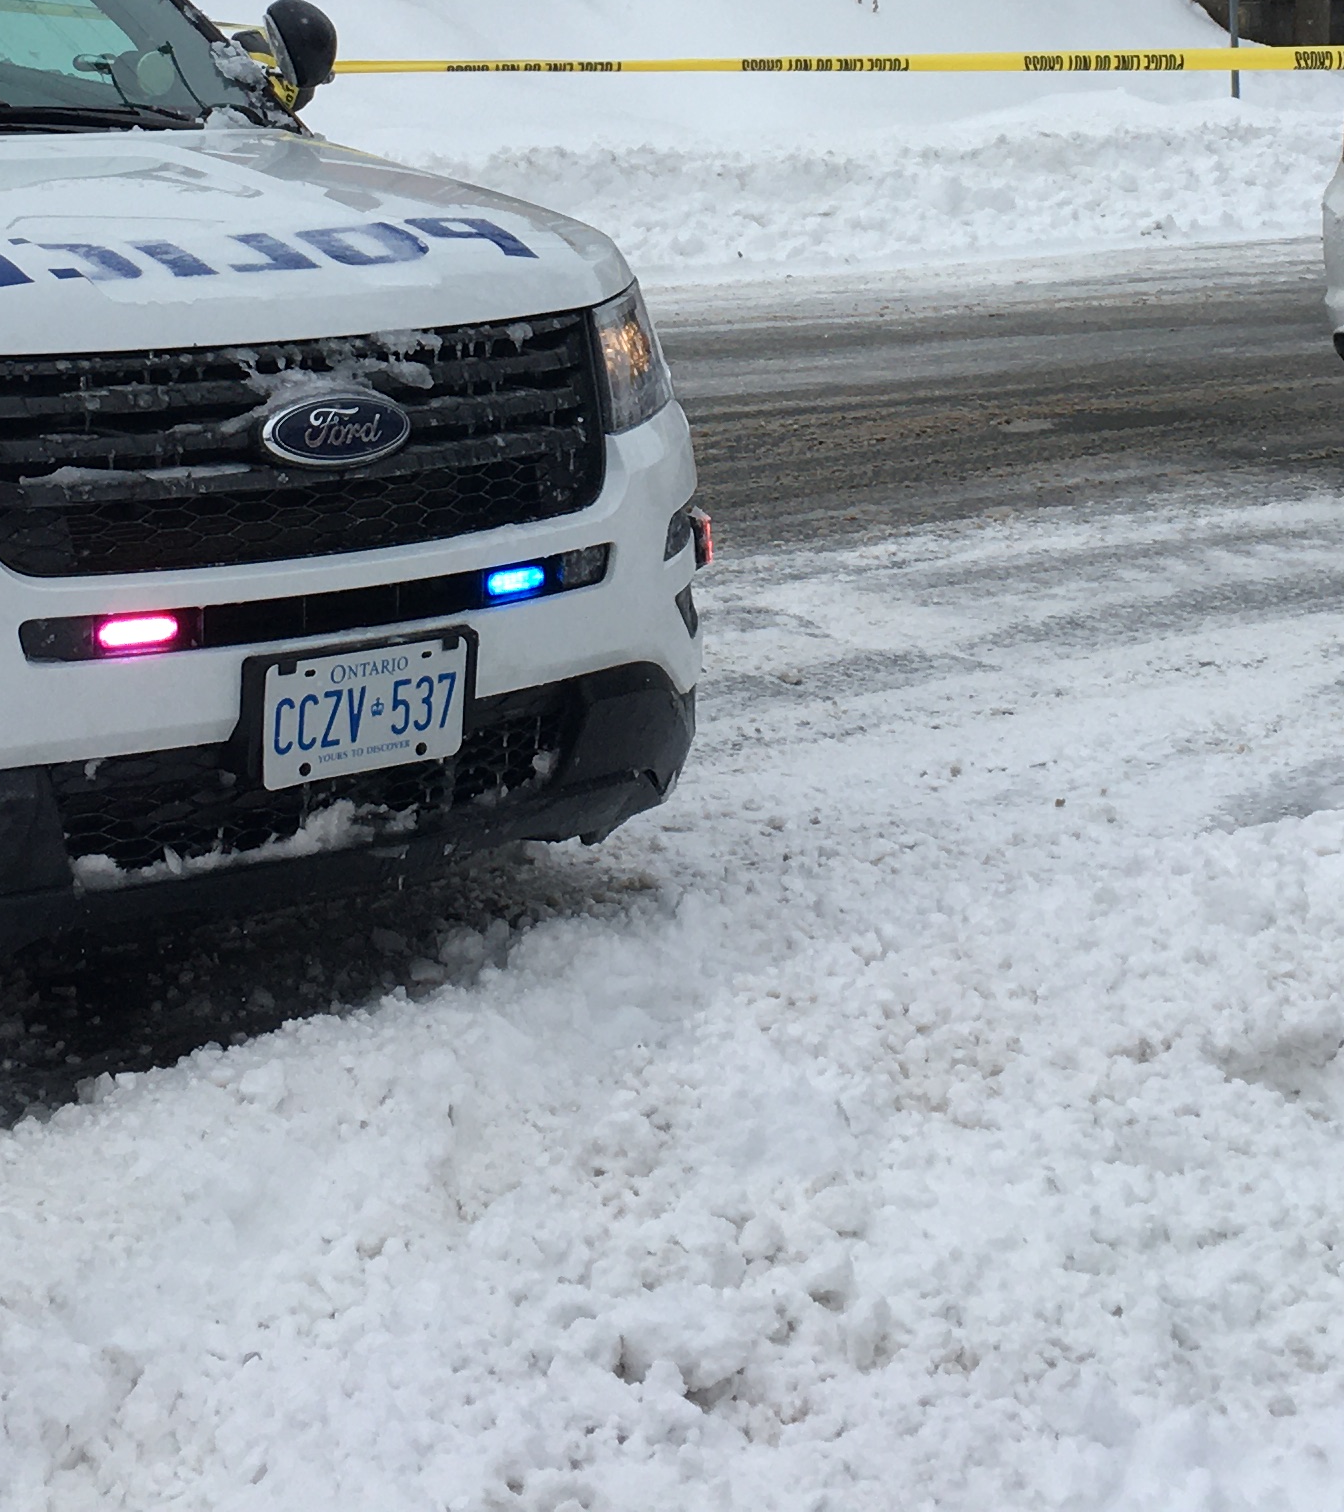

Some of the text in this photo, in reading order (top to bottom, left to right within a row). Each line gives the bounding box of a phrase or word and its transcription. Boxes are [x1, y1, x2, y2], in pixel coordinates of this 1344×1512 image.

[1294, 51, 1333, 70] CROSS
[304, 406, 383, 448] Ford
[330, 656, 409, 684] ONTARIO
[318, 739, 411, 764] YOURS TO DISCOVER
